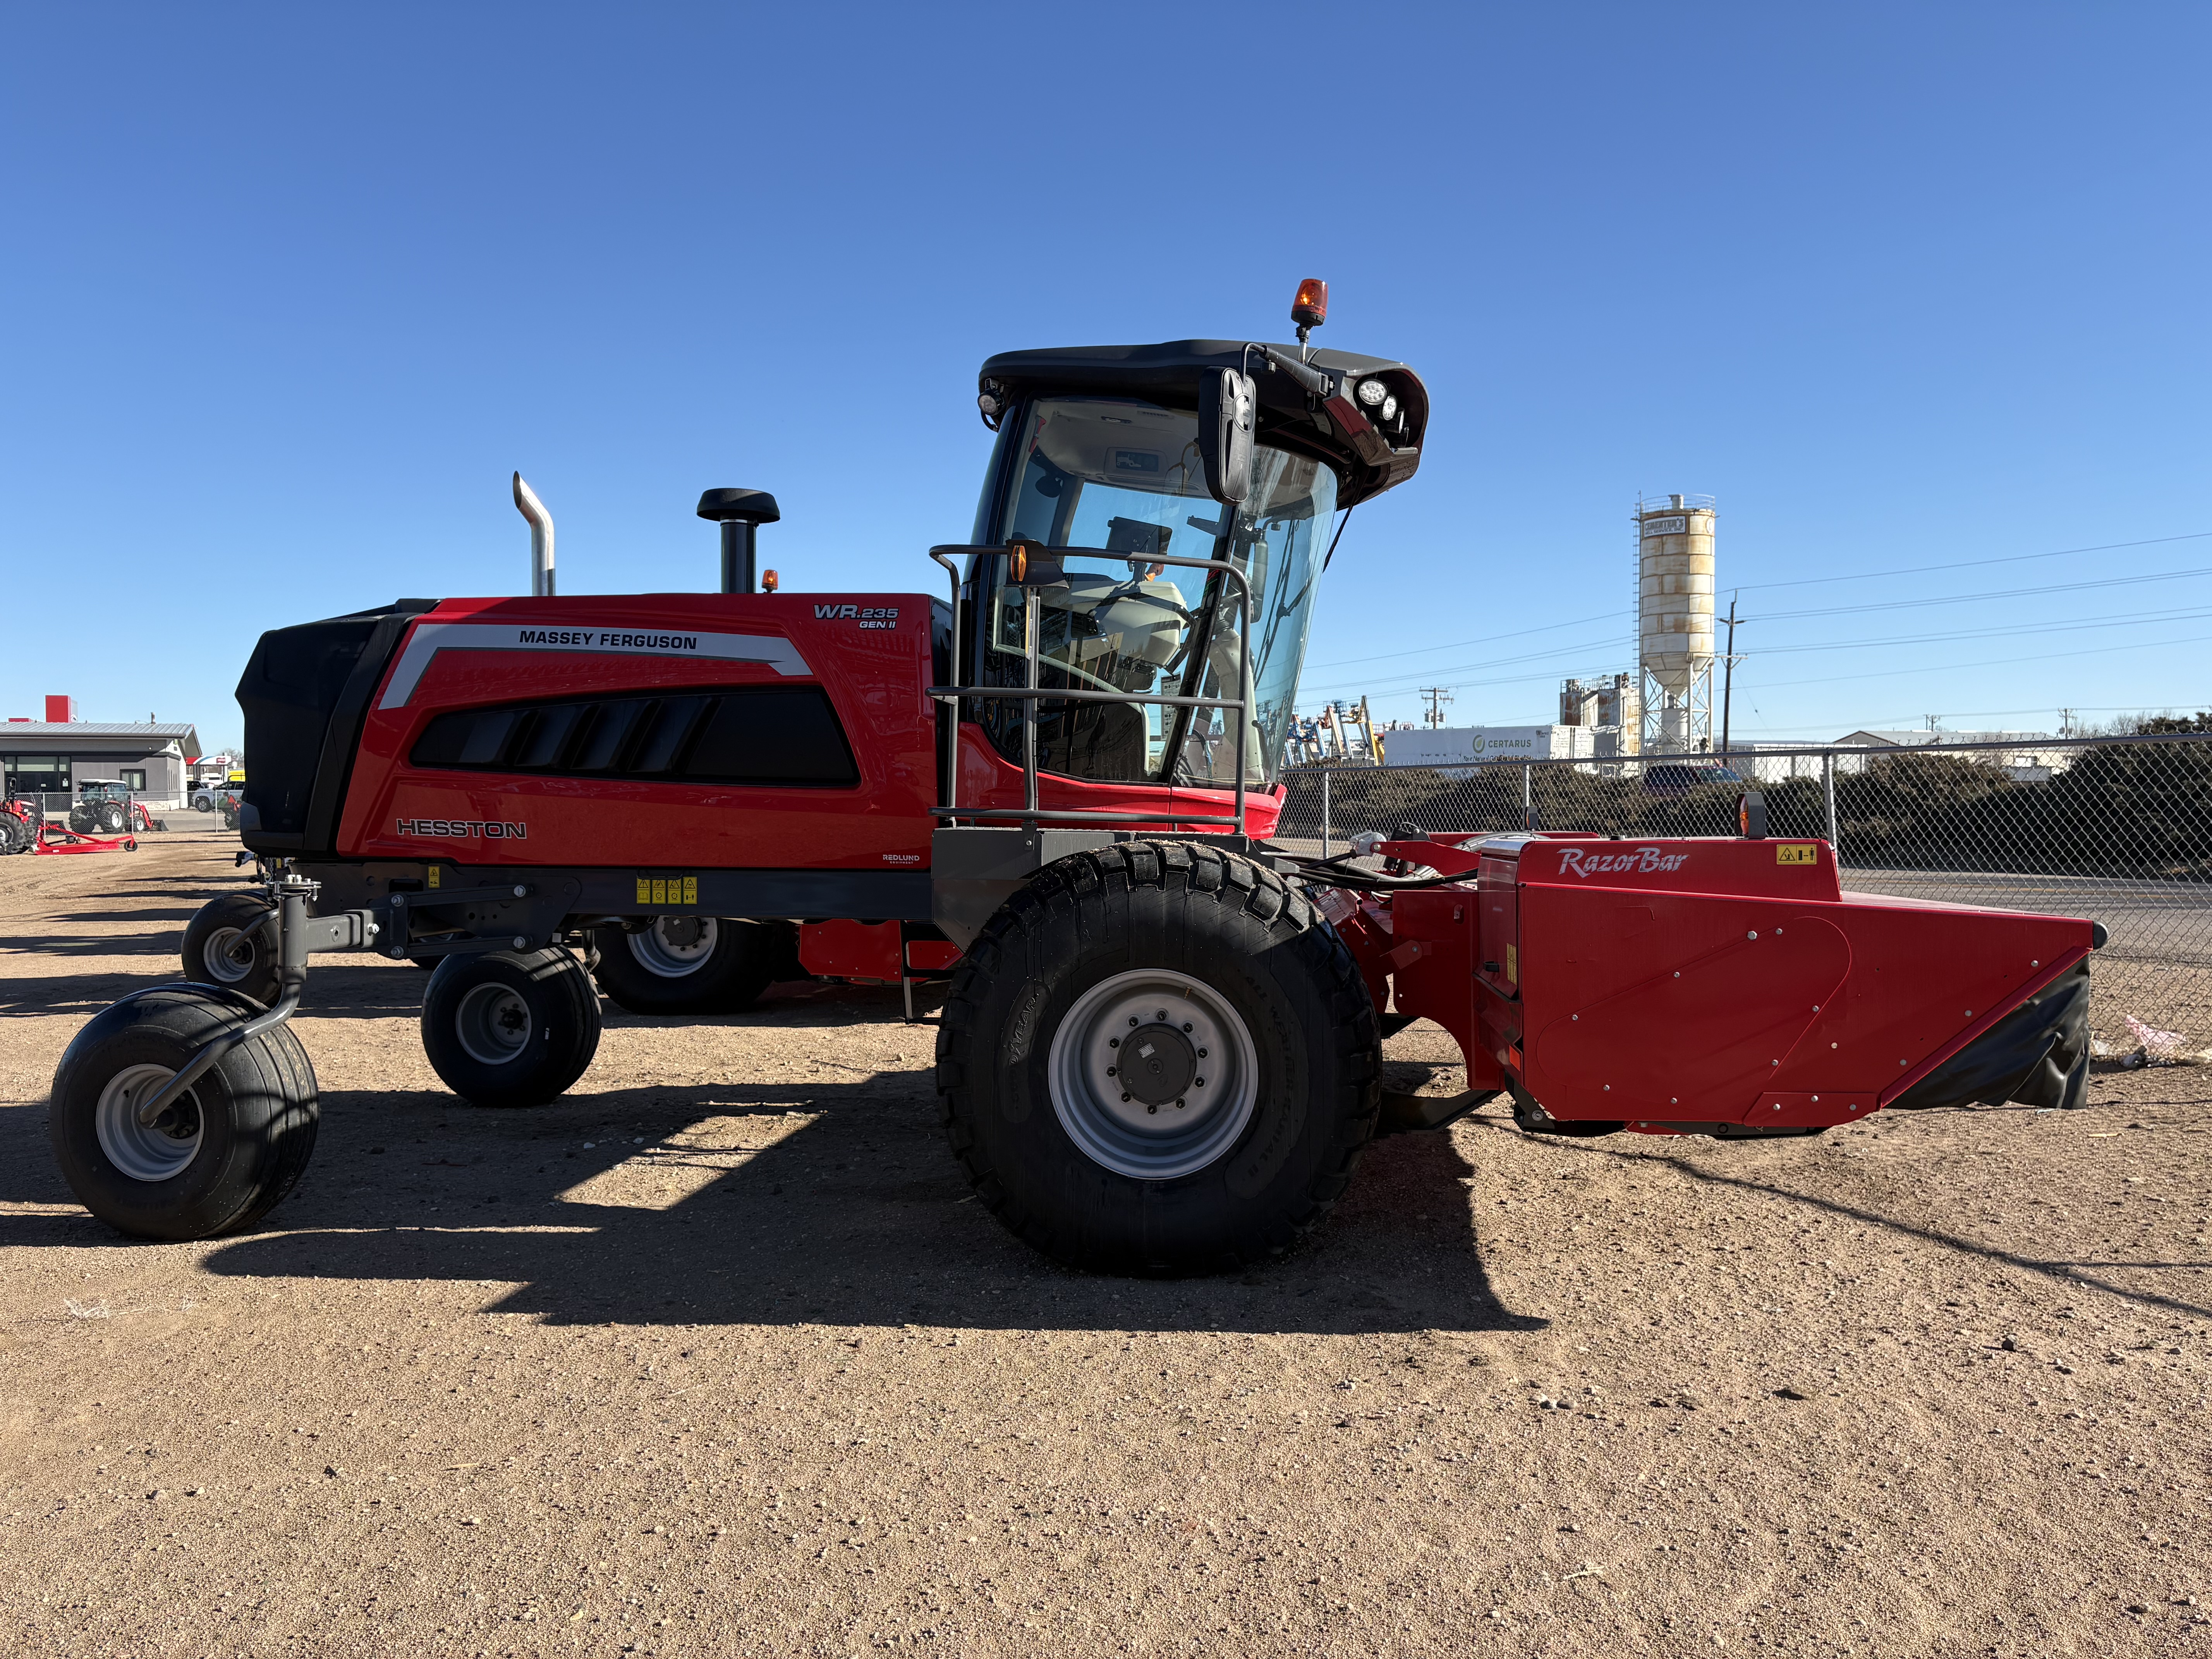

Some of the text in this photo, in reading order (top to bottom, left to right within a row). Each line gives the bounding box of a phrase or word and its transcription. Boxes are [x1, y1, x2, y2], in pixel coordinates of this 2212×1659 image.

[519, 630, 697, 649] MASSEY FERGUSON
[1488, 739, 1531, 748] CERTARUS
[397, 818, 527, 839] HESSTON
[1556, 847, 1690, 878] RazorBar
